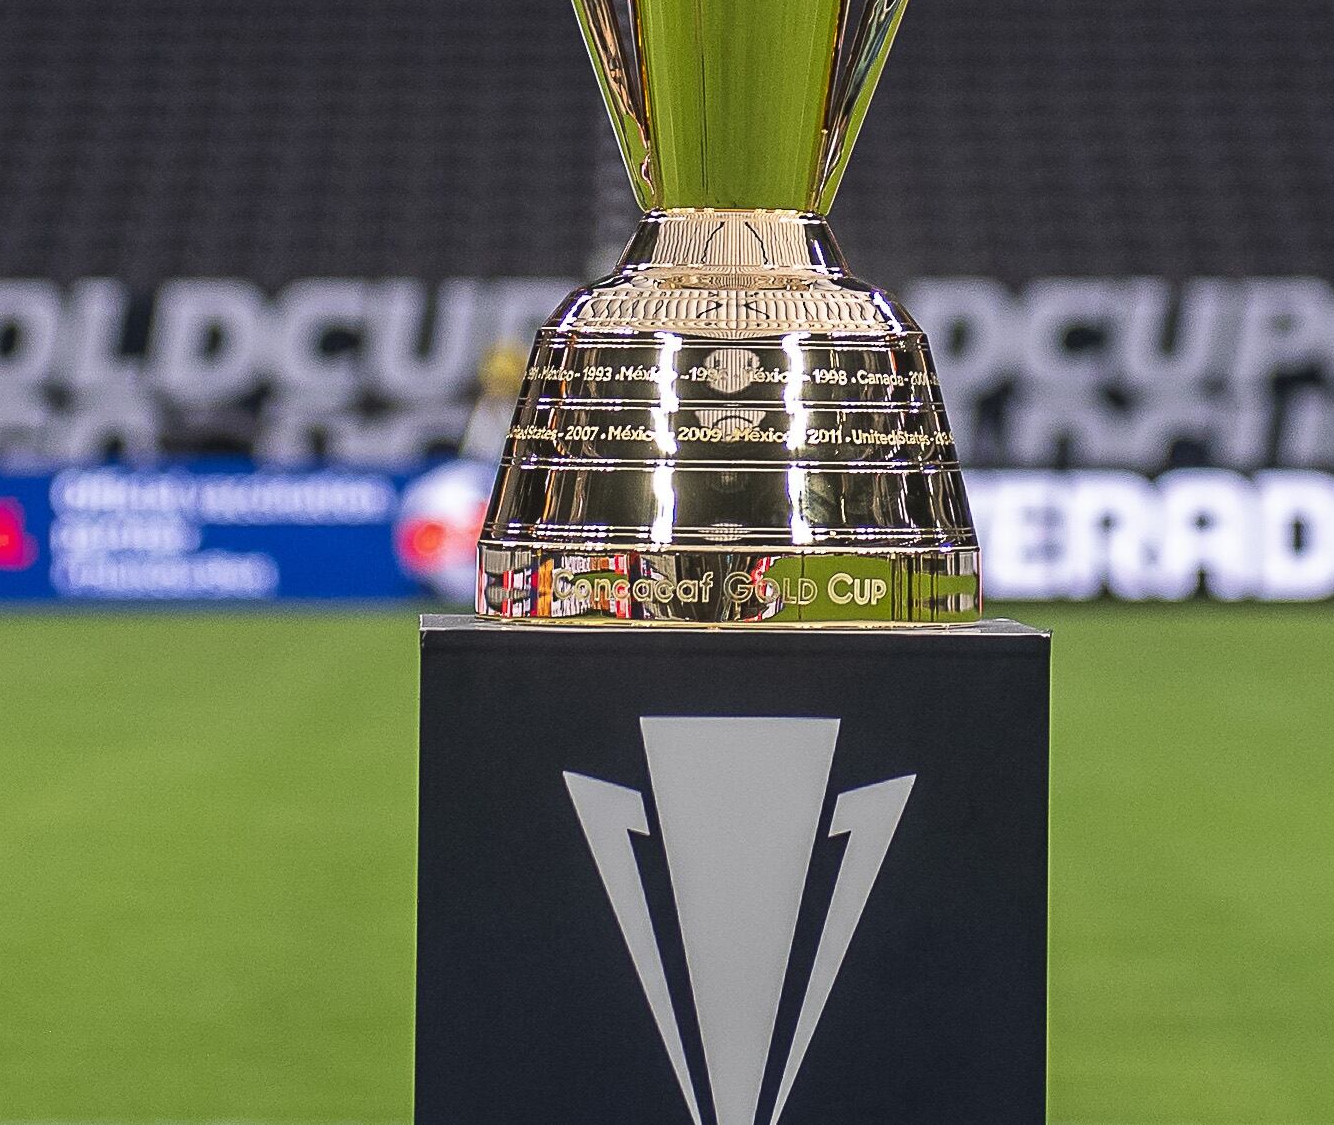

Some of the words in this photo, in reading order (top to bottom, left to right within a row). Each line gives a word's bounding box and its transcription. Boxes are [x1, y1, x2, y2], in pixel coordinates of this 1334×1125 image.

[582, 365, 613, 382] 1993
[812, 368, 848, 386] 1998
[856, 369, 905, 387] Canada
[564, 425, 600, 442] 2007
[607, 424, 666, 442] Méxic
[677, 426, 723, 443] 2009
[806, 428, 843, 444] 2011
[851, 428, 896, 445] United
[552, 568, 715, 604] Concacaf
[723, 570, 819, 606] GOLD
[827, 571, 888, 606] CUP
